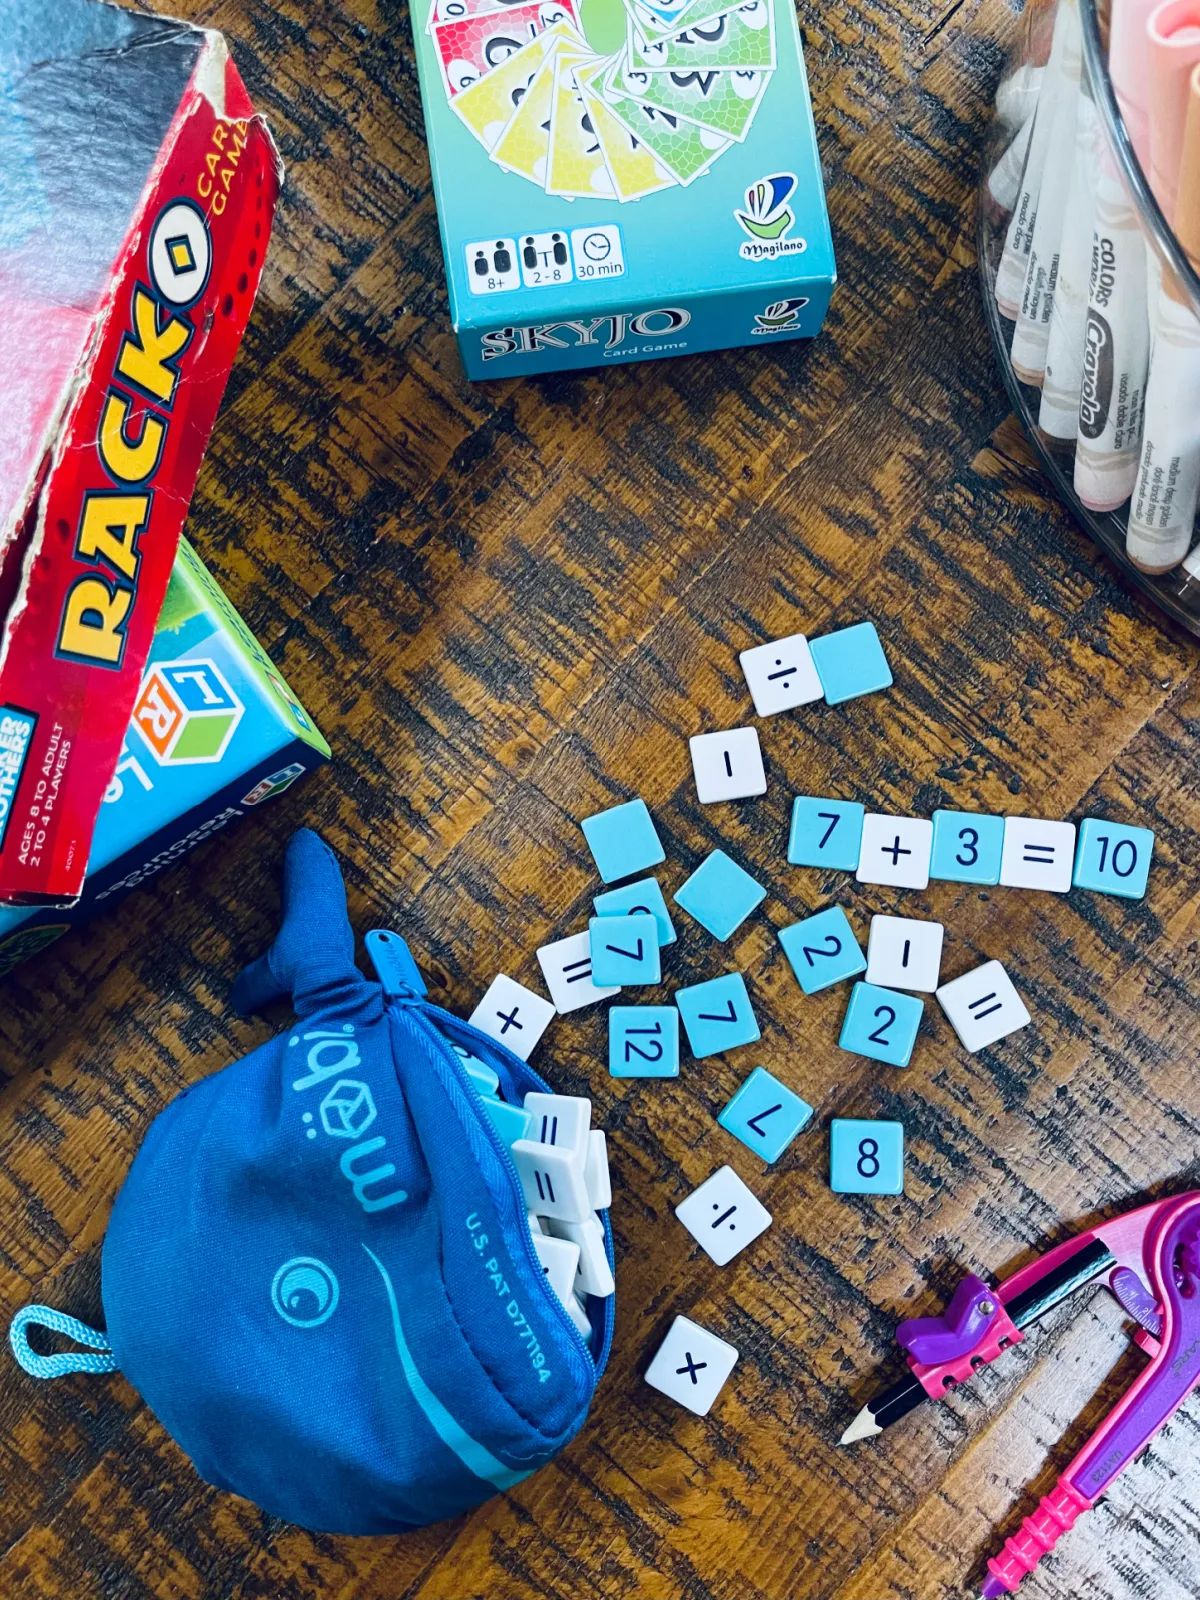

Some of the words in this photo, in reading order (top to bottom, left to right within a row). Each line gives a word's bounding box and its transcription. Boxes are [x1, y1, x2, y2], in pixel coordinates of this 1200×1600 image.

[743, 241, 803, 258] Magilano
[487, 278, 506, 290] 8+
[578, 265, 595, 278] 30
[598, 262, 623, 276] min
[1095, 238, 1116, 308] COLORS
[481, 308, 692, 361] SKYJO
[603, 346, 638, 358] Card
[642, 341, 688, 353] Game
[1080, 316, 1107, 426] Crayola
[1167, 456, 1180, 487] medium
[1159, 505, 1173, 528] golden
[41, 722, 63, 776] ADULT
[34, 780, 47, 801] TO
[45, 740, 71, 810] PLAYERS
[30, 805, 40, 817] 8
[41, 816, 51, 826] 4
[18, 822, 36, 865] AGES
[33, 830, 46, 851] TO
[95, 806, 237, 901] Resources
[125, 808, 244, 888] Learning
[817, 812, 841, 849] 7
[955, 827, 979, 866] 3
[1096, 836, 1137, 877] 10
[30, 856, 40, 867] 2
[606, 938, 644, 962] 7
[803, 935, 842, 967] 2
[698, 1000, 738, 1023] 7
[868, 1005, 896, 1045] 2
[625, 1022, 664, 1063] 12
[857, 1138, 880, 1178] 8
[466, 1212, 488, 1257] U.S.
[485, 1257, 510, 1296] PAT
[506, 1300, 551, 1383] D771194
